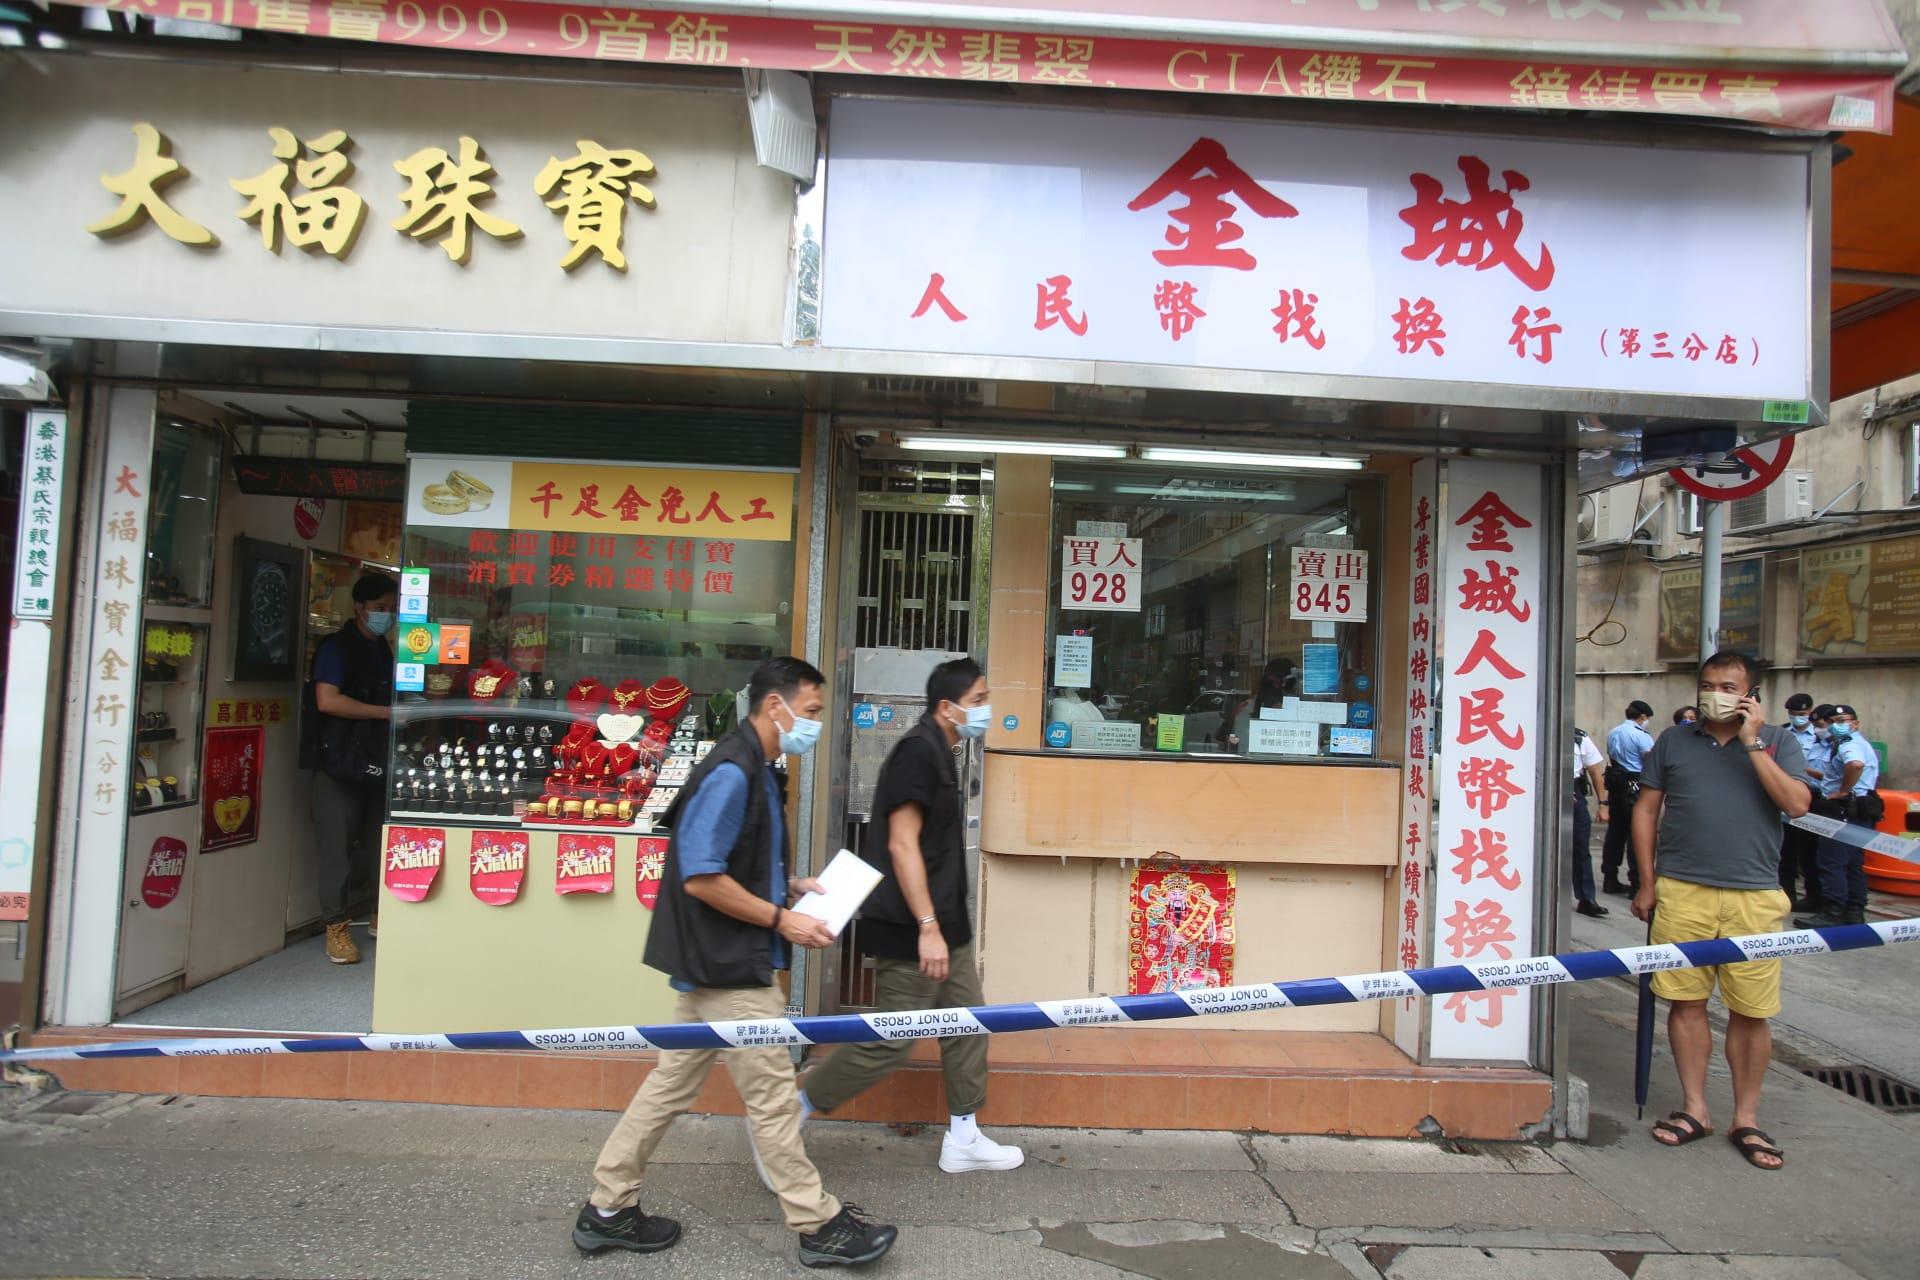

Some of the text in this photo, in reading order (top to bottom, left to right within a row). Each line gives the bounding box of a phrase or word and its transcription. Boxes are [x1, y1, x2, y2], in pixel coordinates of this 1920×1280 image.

[86, 122, 658, 272] 大福珠寶
[1127, 137, 1555, 291] 金城
[911, 273, 1760, 366] 人民幣找換行 (第三分店)
[26, 421, 60, 588] 香港蔡氏宗親總會
[530, 481, 775, 525] 千足金免人工
[468, 531, 737, 565] 歡迎使用支付寶
[1070, 540, 1137, 568] 買入
[1297, 551, 1363, 580] 賣出
[467, 559, 735, 594] 消費券精選特價
[1071, 572, 1127, 603] 928
[22, 597, 50, 611] 三樓
[1296, 583, 1351, 613] 845
[857, 711, 873, 719] ADT
[1353, 709, 1369, 719] ADT
[1050, 730, 1066, 739] ADT
[393, 841, 416, 853] SALE
[477, 845, 500, 857] SALE
[564, 849, 586, 861] SALE
[642, 852, 665, 864] SALE
[1743, 935, 1809, 949] DO NOT CROSS
[1477, 962, 1549, 977] DO NOT CROSS
[1533, 974, 1566, 983] POLICE
[1190, 989, 1268, 1004] DO NOT CROSS
[1242, 1001, 1286, 1011] POLICE
[874, 1013, 959, 1027] DO NOT CROSS
[940, 1026, 979, 1035] POLICE
[536, 1032, 625, 1044] DO NOT CROSS
[254, 1047, 273, 1055] DO
